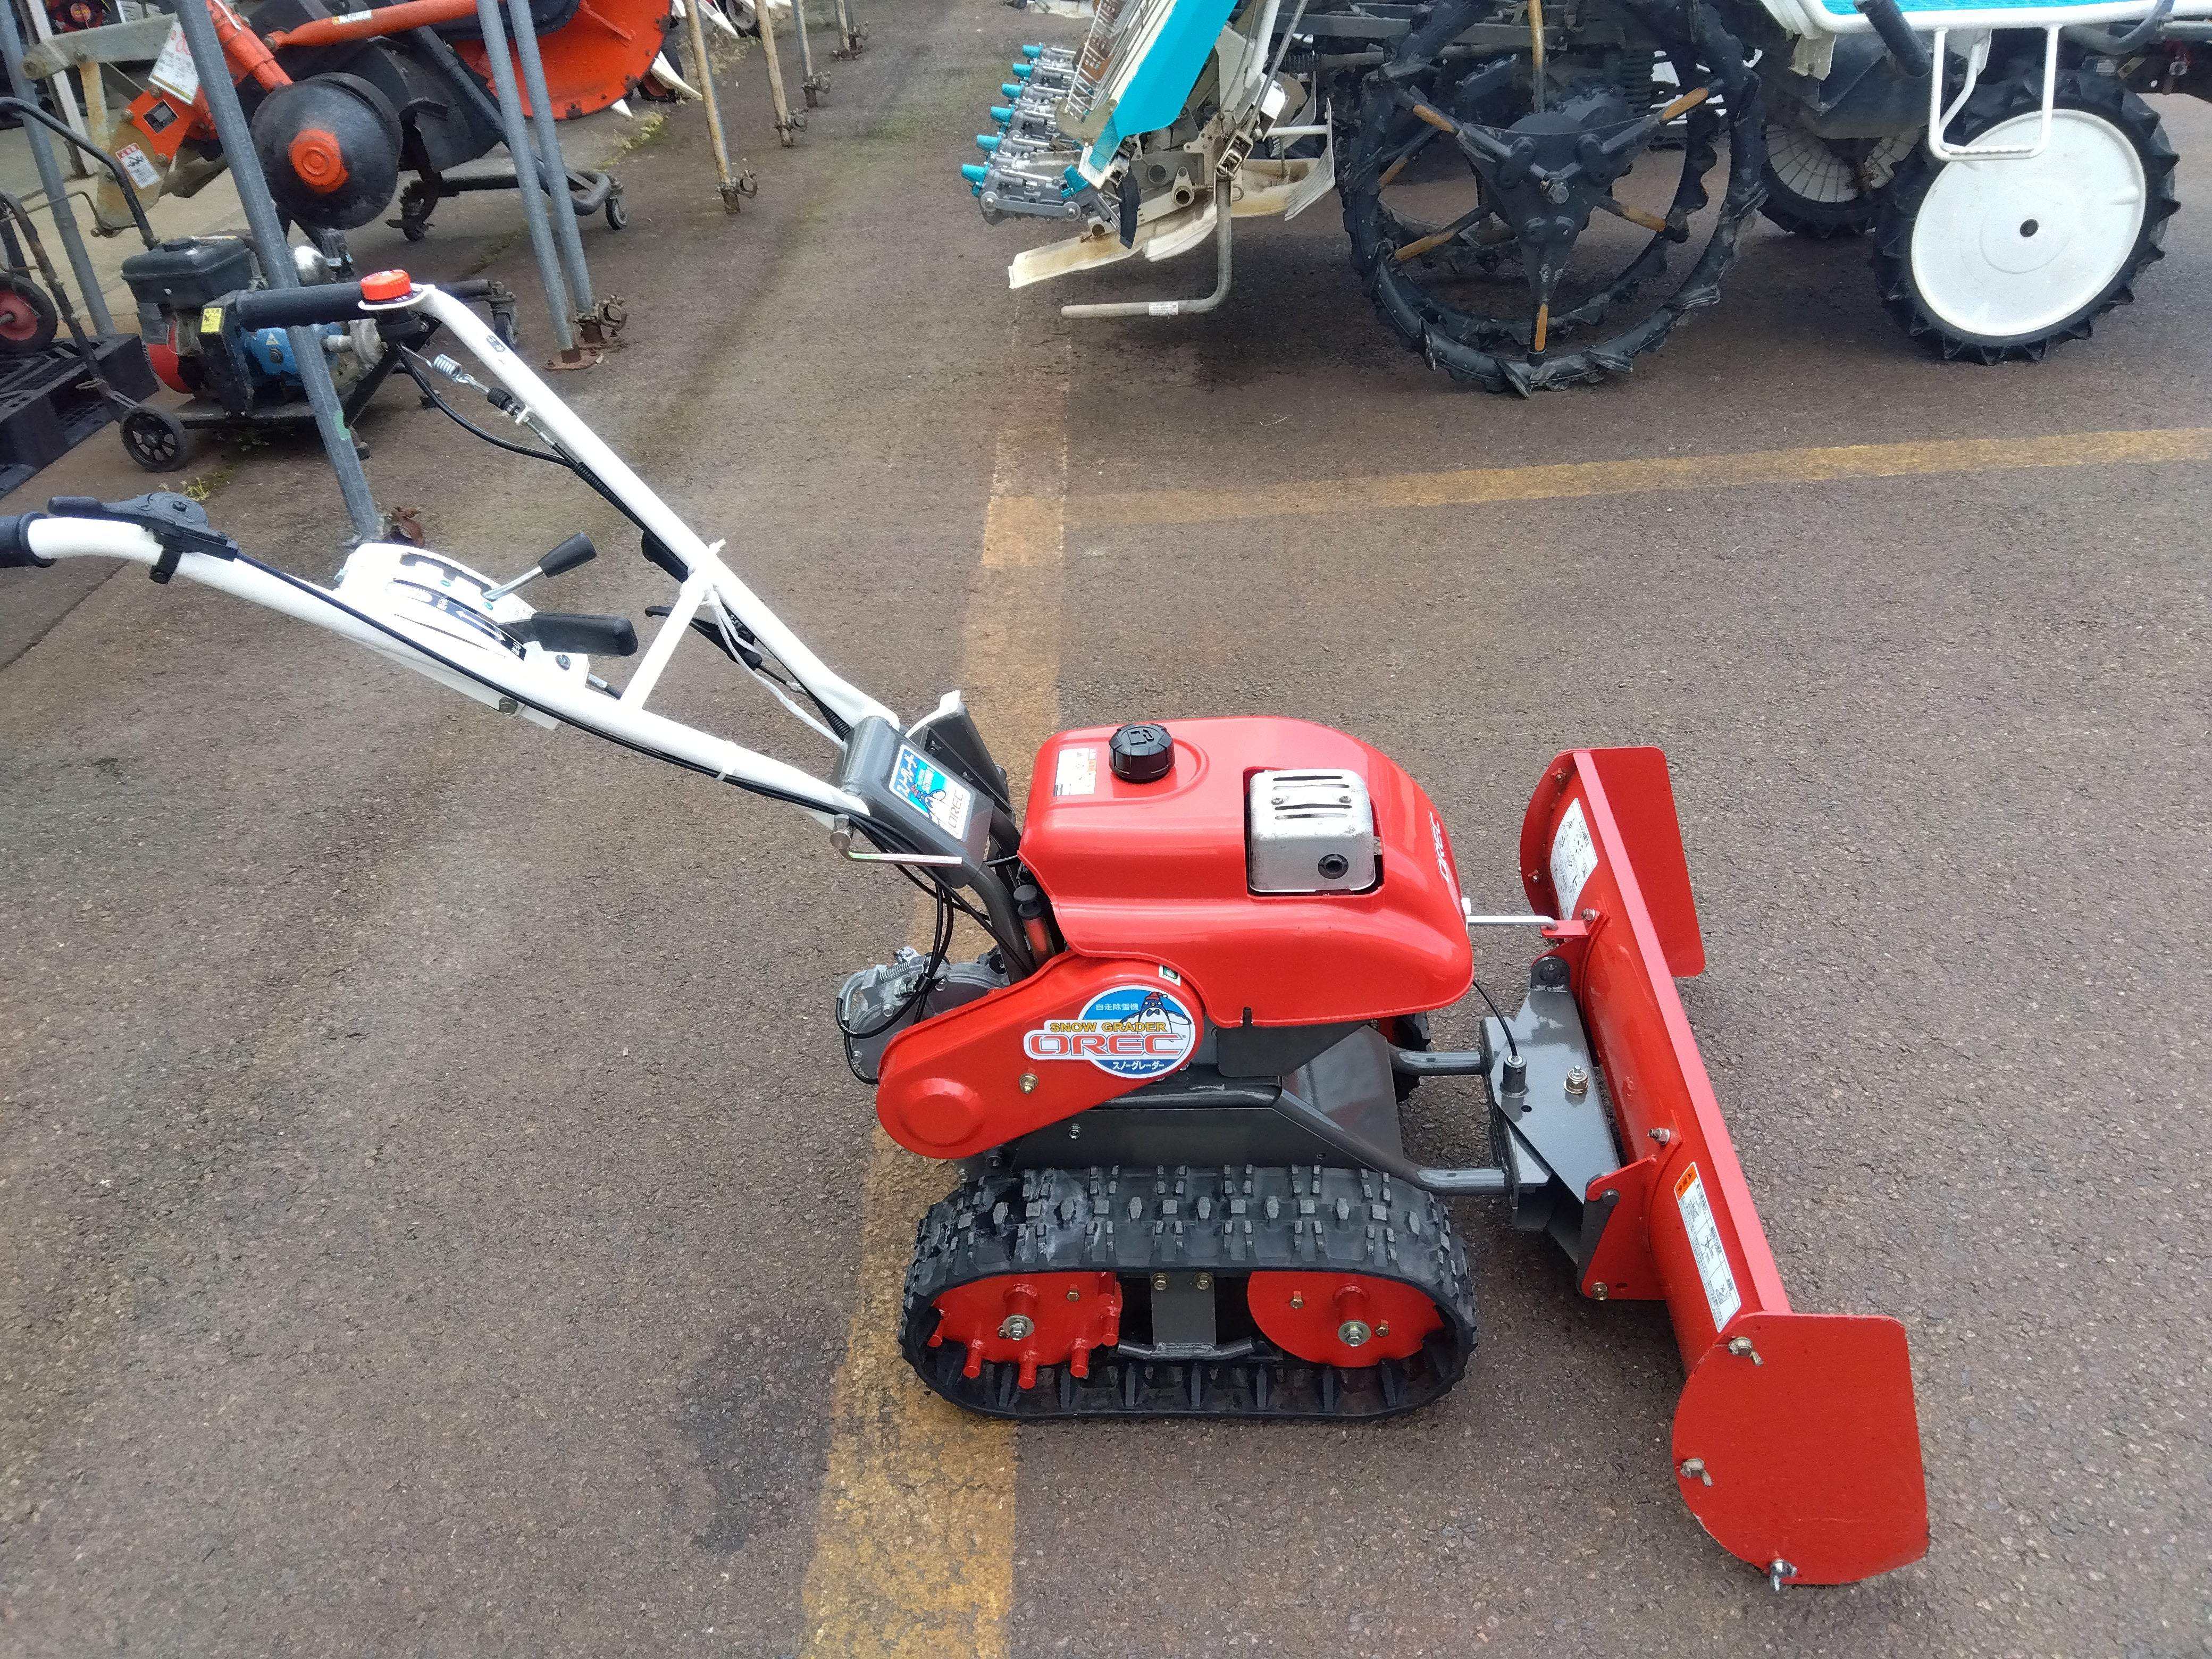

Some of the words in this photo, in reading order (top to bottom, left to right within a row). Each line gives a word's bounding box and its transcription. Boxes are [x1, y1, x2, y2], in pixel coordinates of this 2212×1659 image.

[948, 789, 963, 828] OREC
[1429, 811, 1450, 884] OREC
[1050, 1022, 1097, 1033] SNOW
[1101, 1021, 1168, 1033] GRADER
[1029, 1033, 1185, 1056] OREC
[1112, 1060, 1164, 1070] スノーグレーダー
